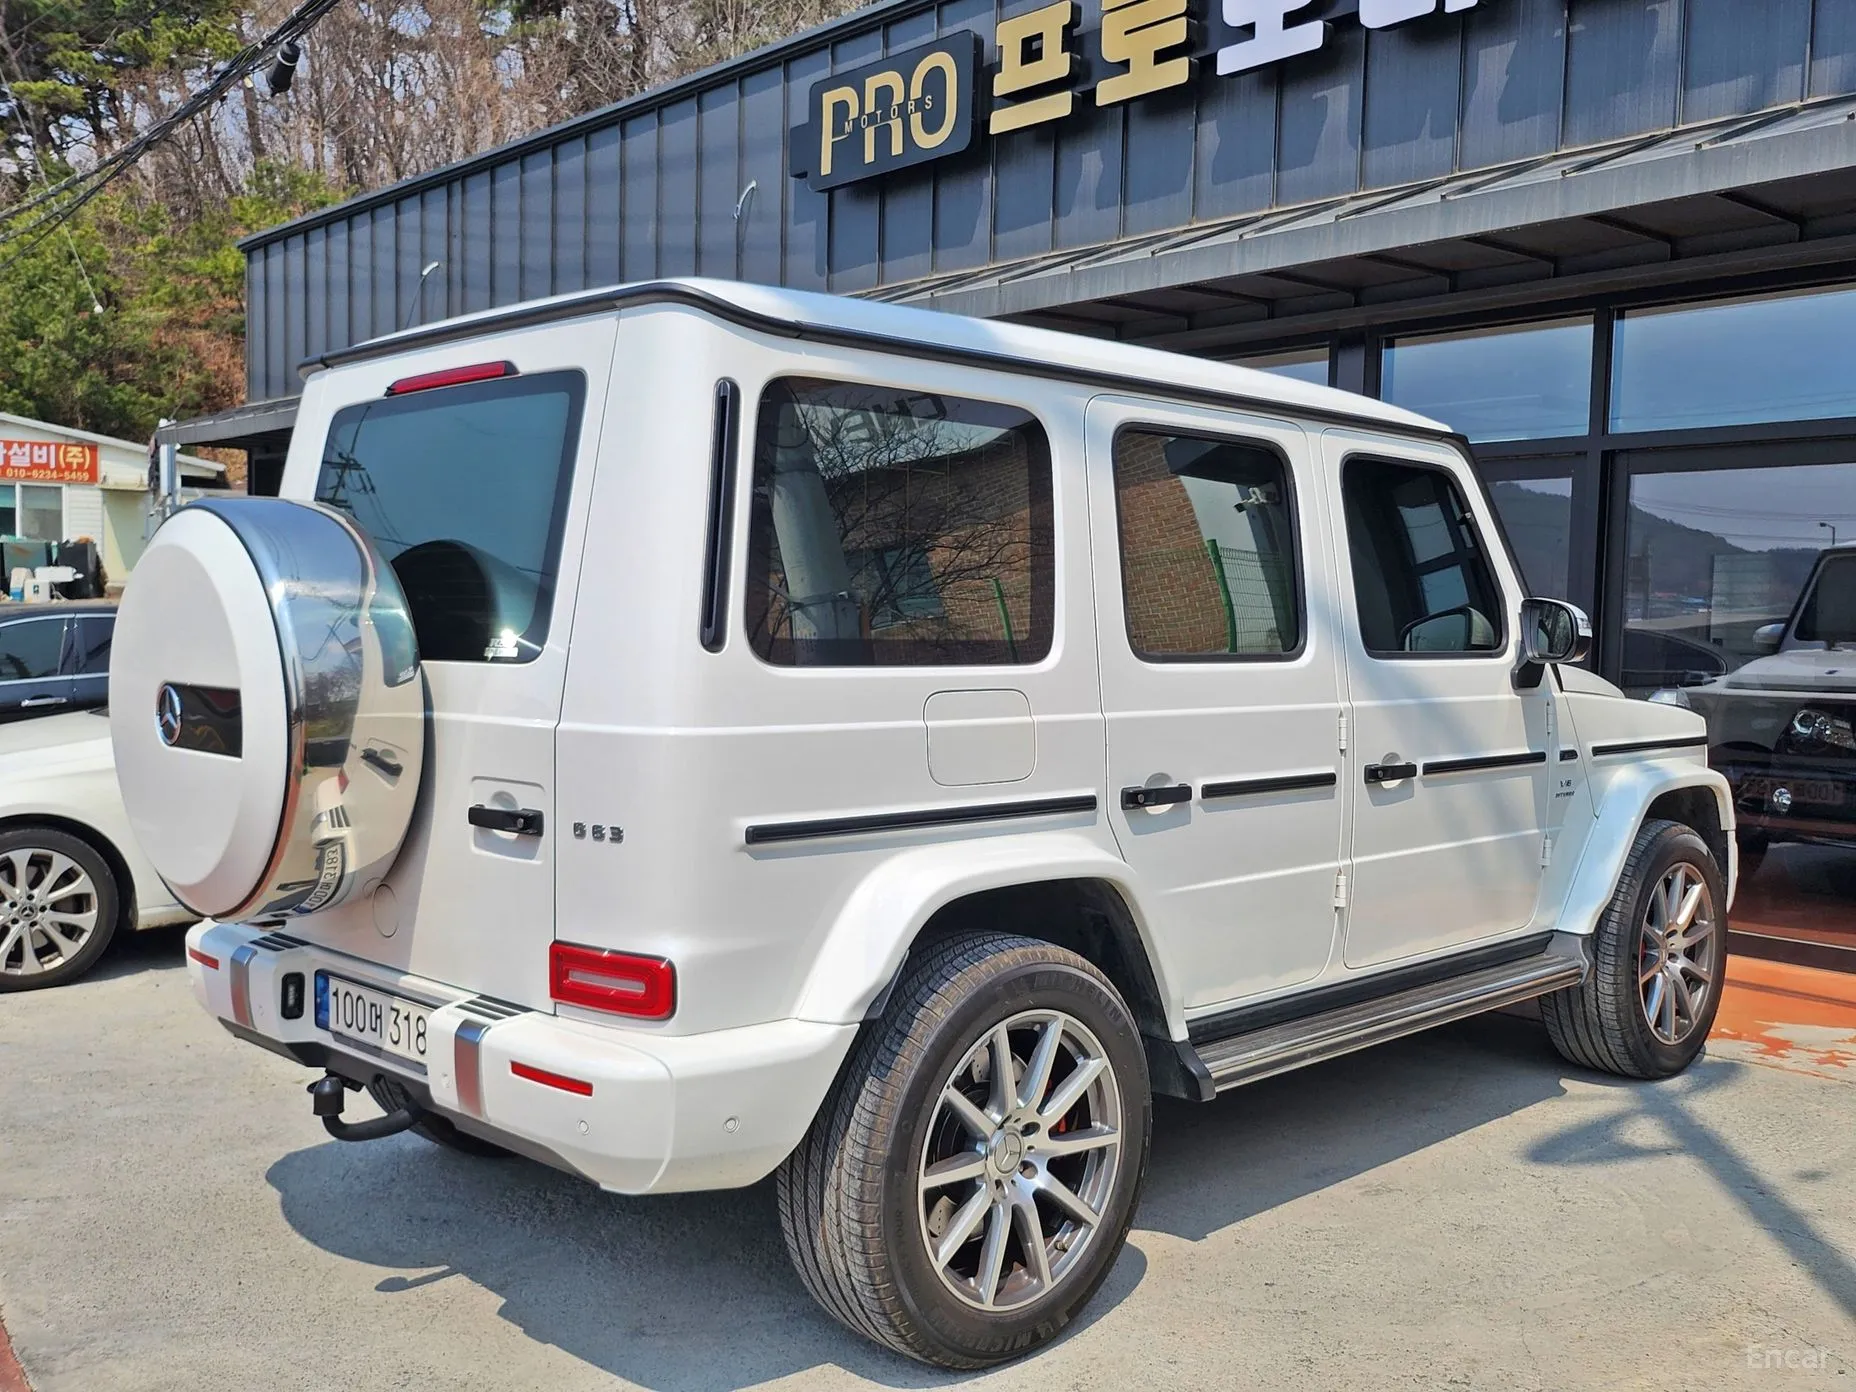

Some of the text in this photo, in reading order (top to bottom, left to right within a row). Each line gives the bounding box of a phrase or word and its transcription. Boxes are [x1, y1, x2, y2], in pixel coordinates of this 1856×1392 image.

[821, 51, 958, 176] PRO
[844, 95, 933, 135] MOTORS
[332, 986, 428, 1056] 100머318
